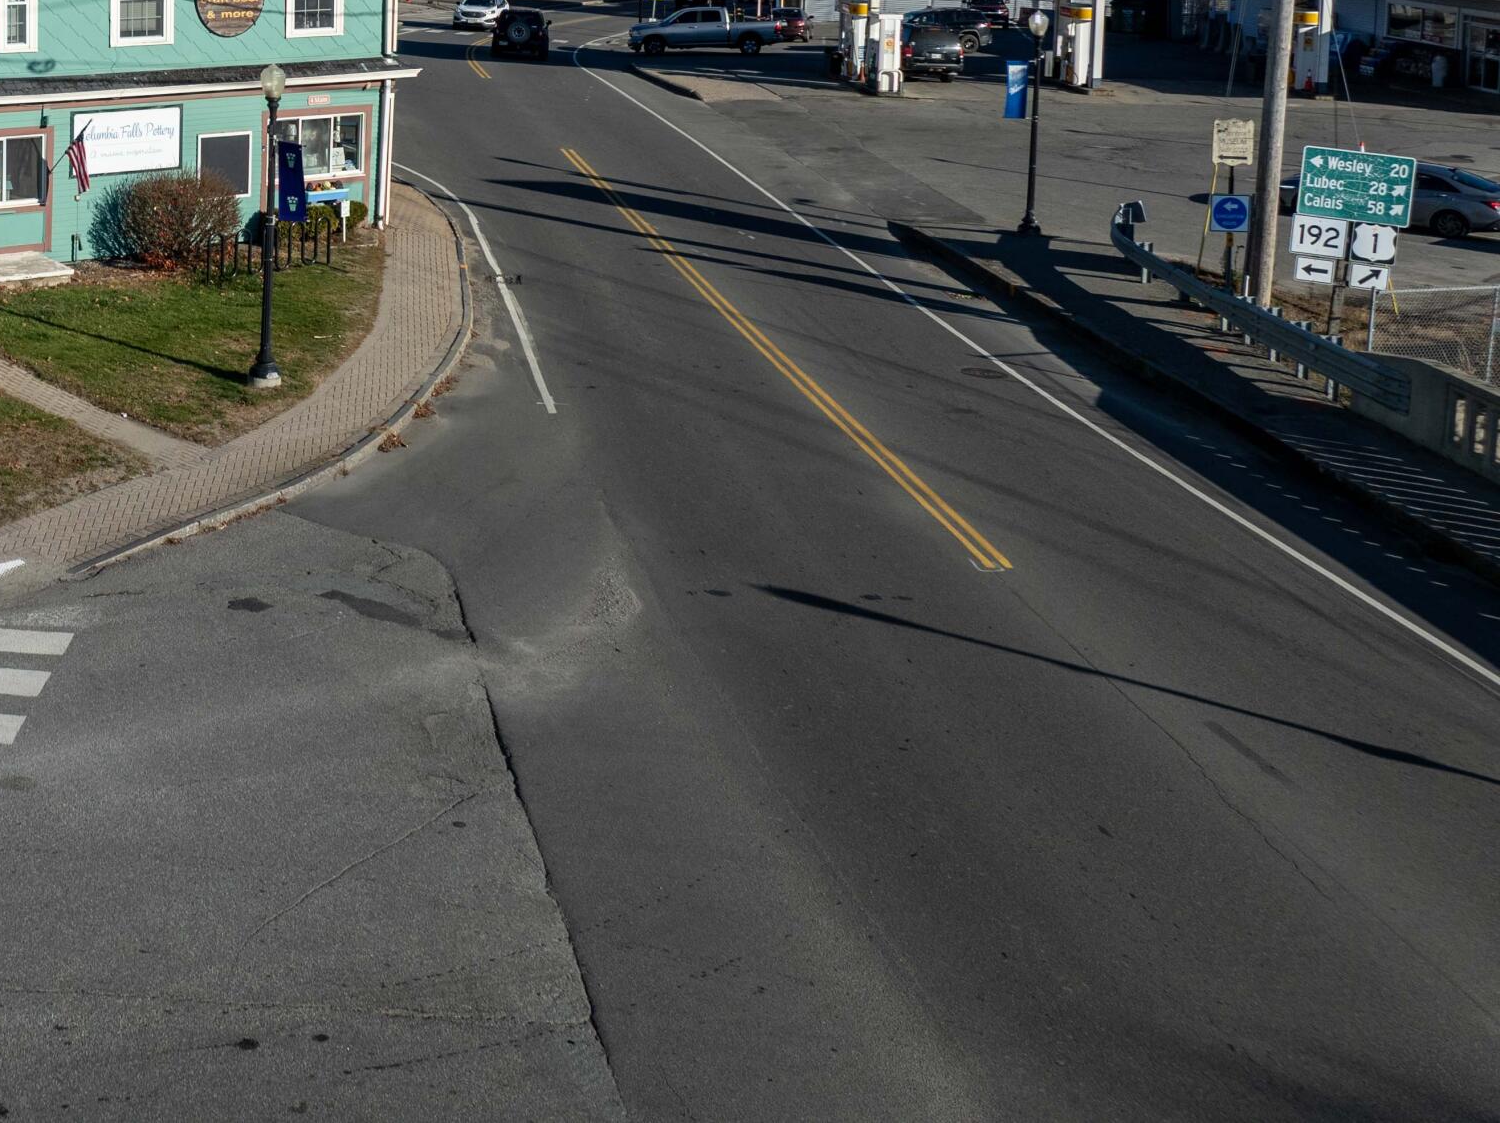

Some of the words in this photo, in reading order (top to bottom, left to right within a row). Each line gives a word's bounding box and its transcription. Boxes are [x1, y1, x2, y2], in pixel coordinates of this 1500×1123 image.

[206, 10, 215, 19] &
[221, 10, 254, 19] more
[83, 126, 118, 142] olumbia
[119, 122, 143, 139] Falls
[144, 122, 176, 140] Pottery
[1327, 156, 1373, 177] Wesley
[1389, 163, 1409, 178] 20
[1306, 173, 1345, 191] Lubec
[1368, 181, 1387, 196] 28
[1304, 192, 1344, 210] Calais
[1366, 200, 1385, 215] 58
[1299, 224, 1340, 250] 192
[1371, 232, 1379, 254] 1
